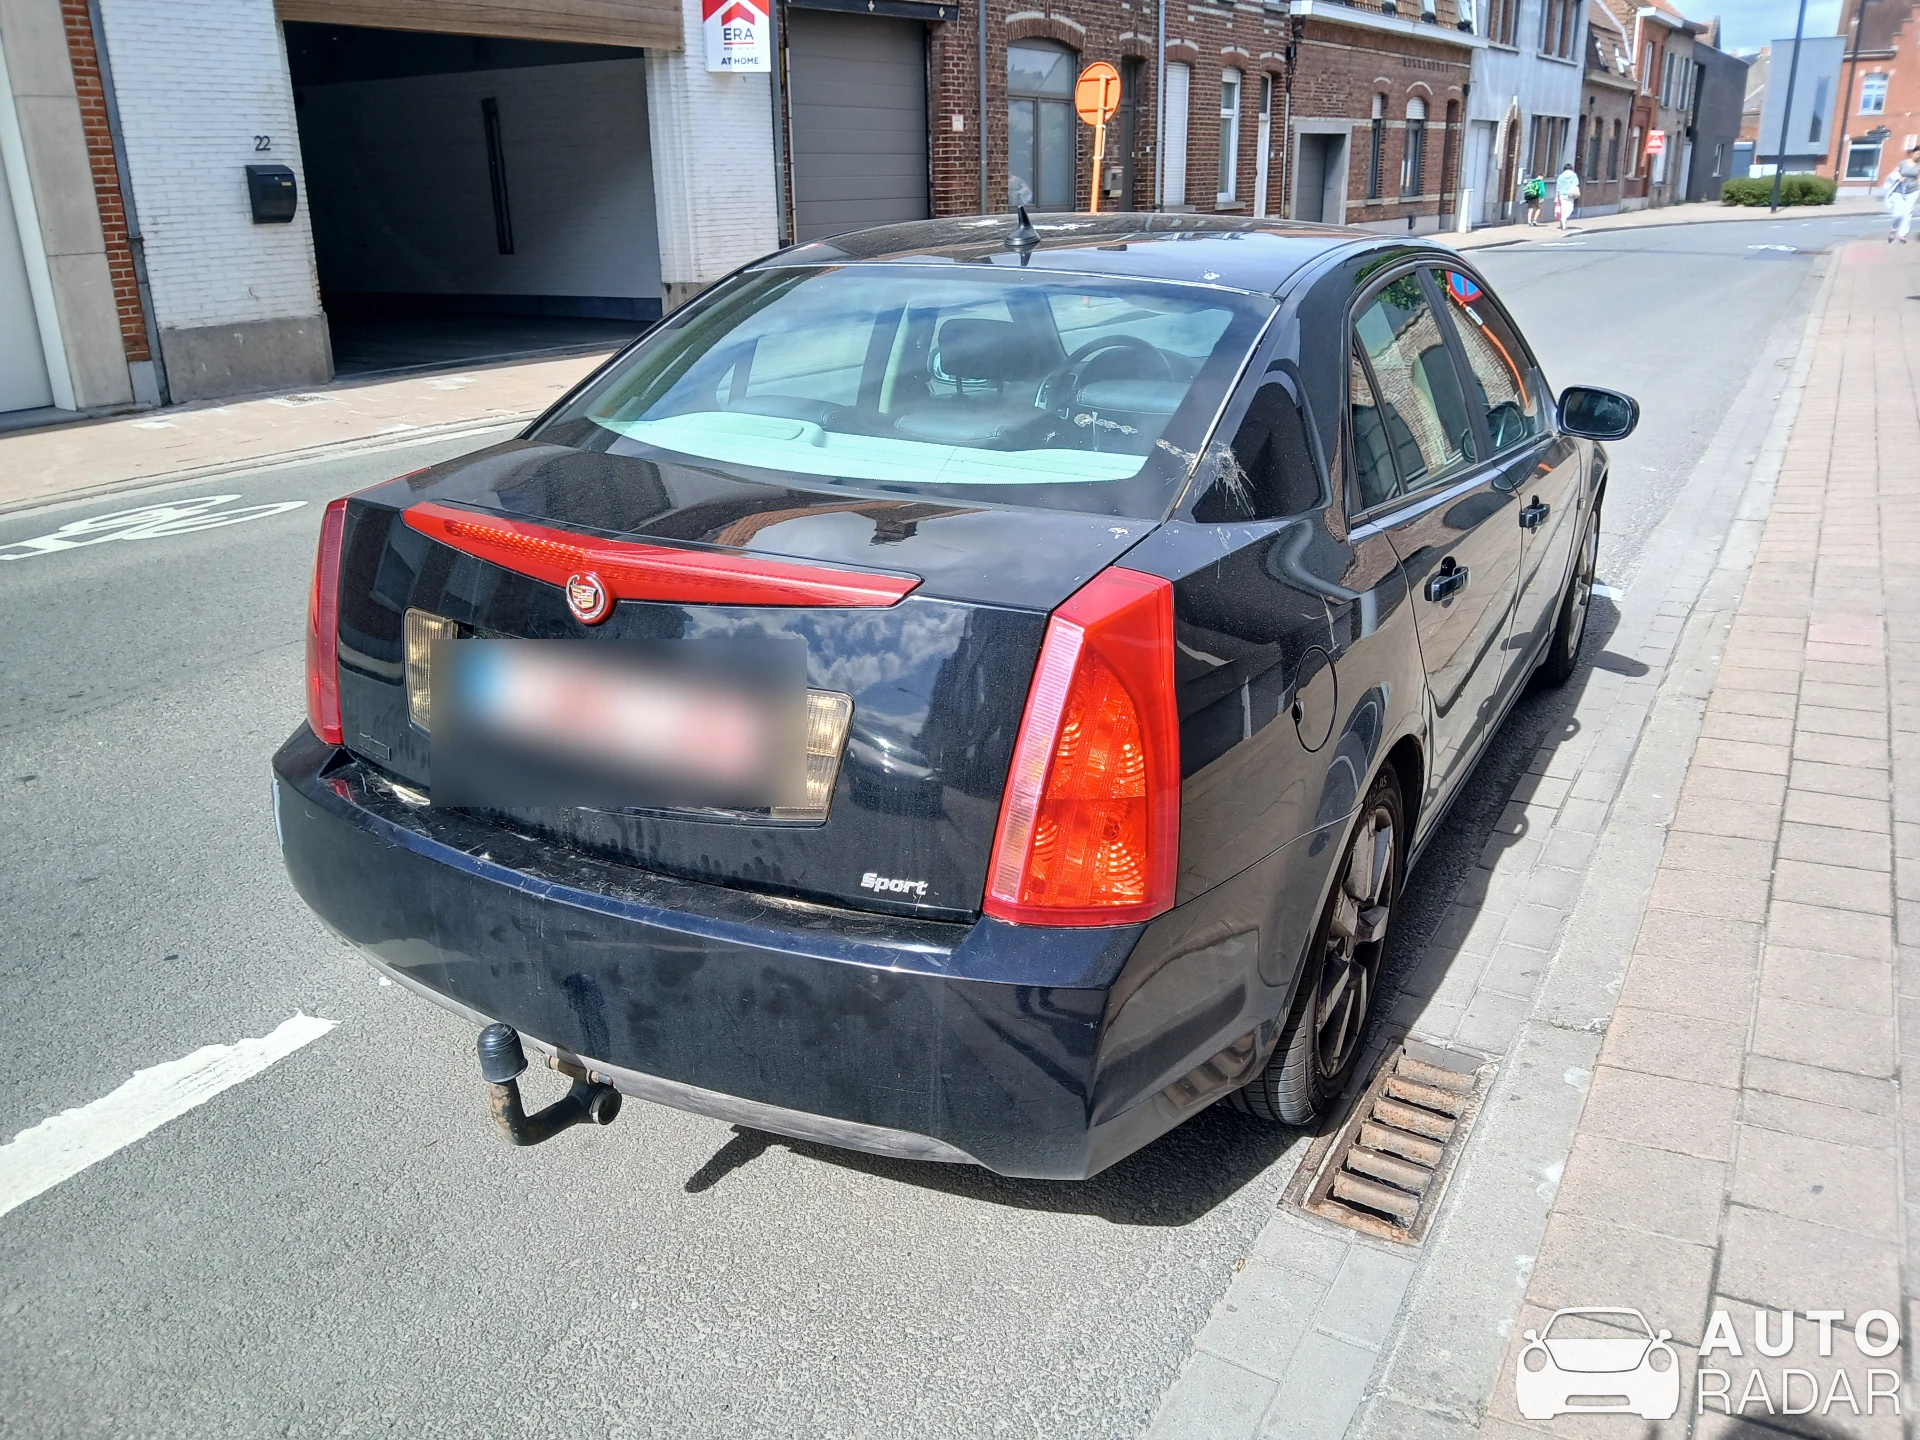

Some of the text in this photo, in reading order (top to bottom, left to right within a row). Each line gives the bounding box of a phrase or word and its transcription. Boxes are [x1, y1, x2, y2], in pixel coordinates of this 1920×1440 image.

[723, 28, 754, 41] ERA
[720, 57, 759, 65] AT HOME
[254, 135, 271, 151] 22
[860, 872, 929, 896] Sport
